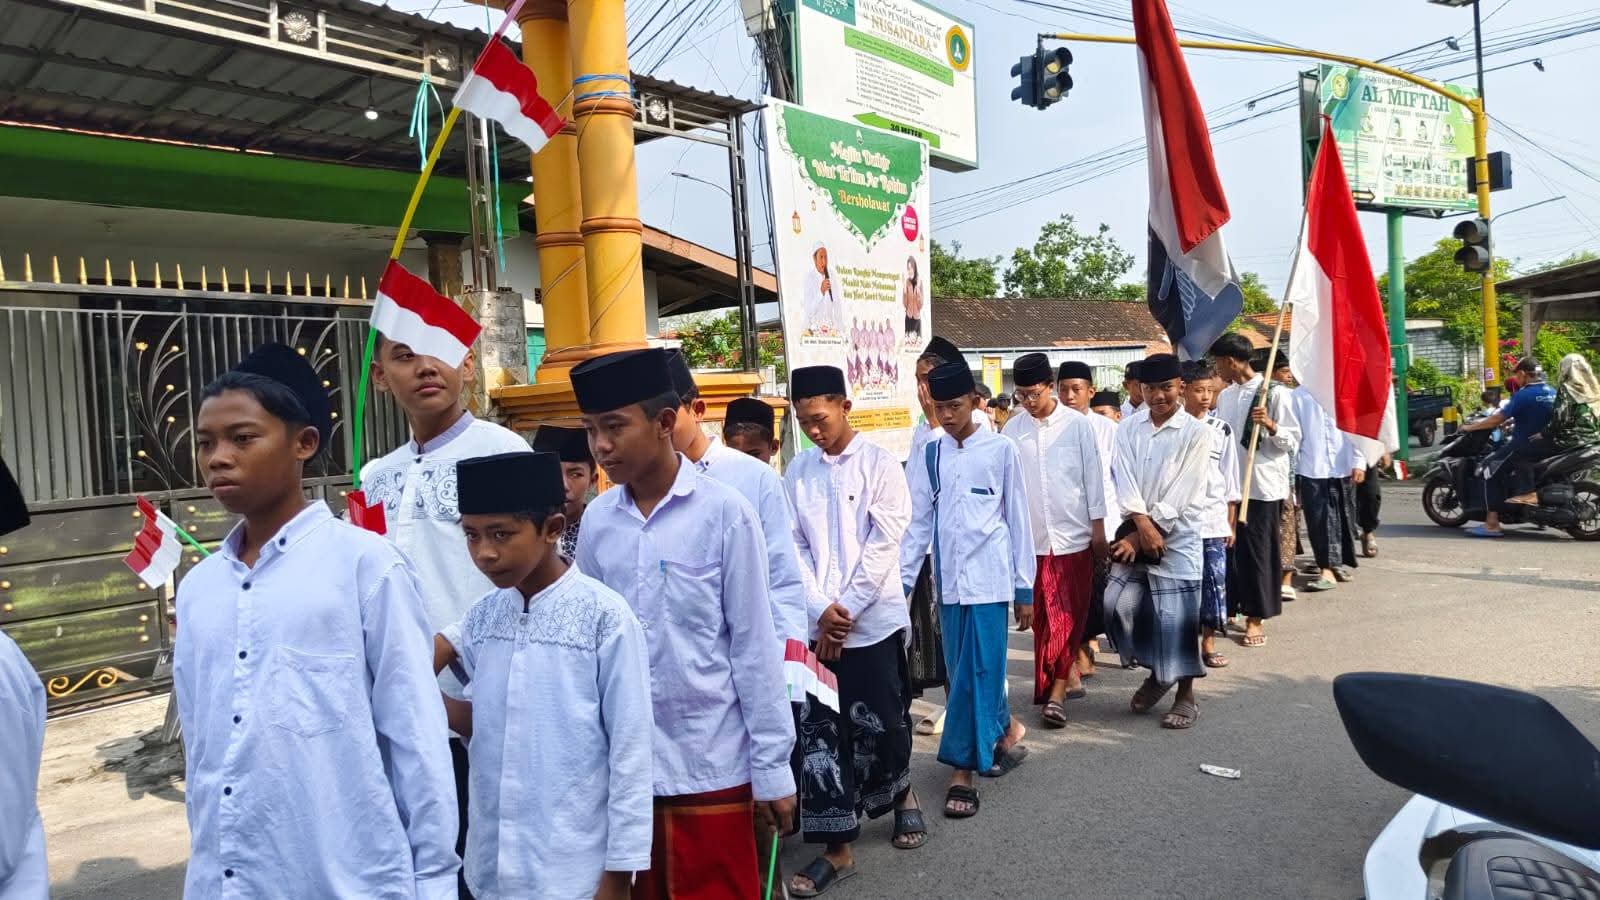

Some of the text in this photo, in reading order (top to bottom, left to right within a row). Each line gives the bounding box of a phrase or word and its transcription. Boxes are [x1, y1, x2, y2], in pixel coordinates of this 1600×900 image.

[871, 15, 932, 52] NUSANTARA
[1361, 84, 1450, 112] AL MIFTAH
[838, 189, 891, 212] Bersholawat
